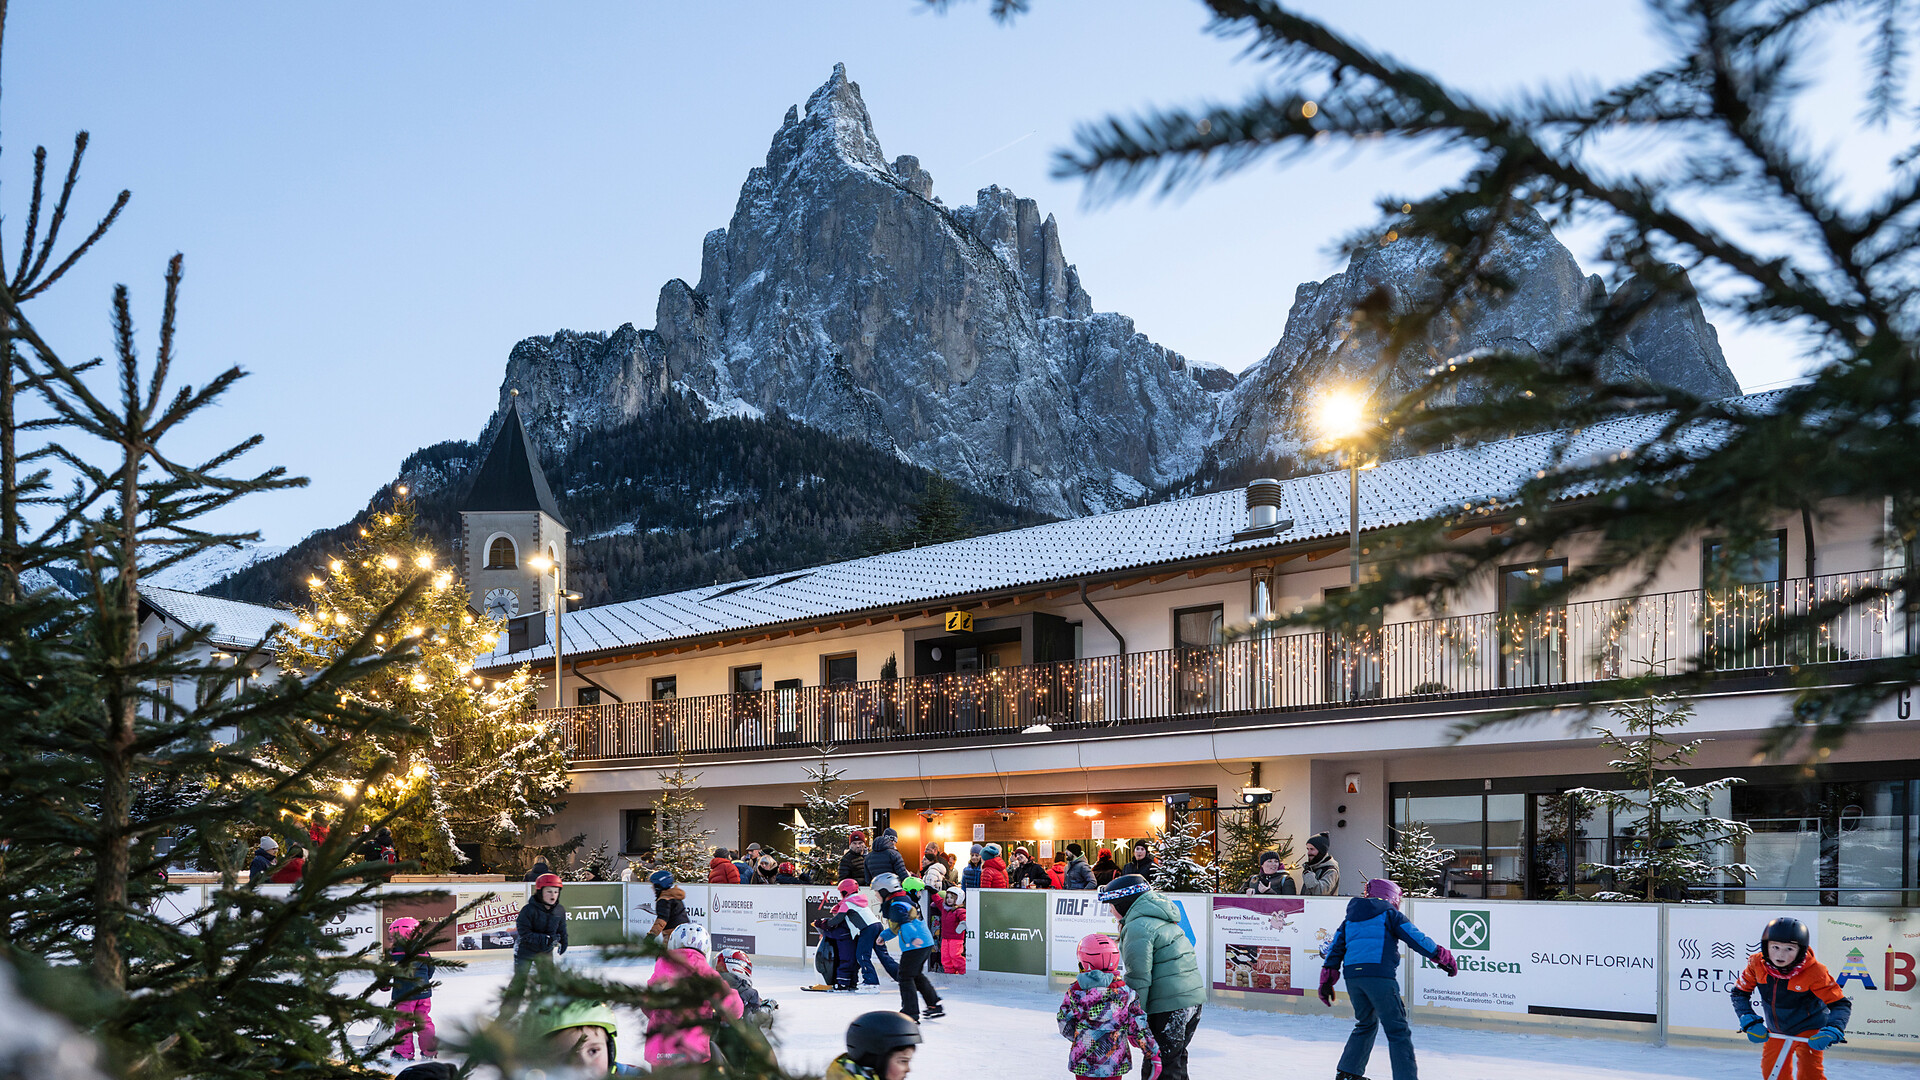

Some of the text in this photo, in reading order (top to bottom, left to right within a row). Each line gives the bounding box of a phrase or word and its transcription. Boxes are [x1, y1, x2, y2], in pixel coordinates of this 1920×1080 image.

[721, 900, 753, 910] JOCHBERGER
[807, 891, 839, 910] OBEXER
[475, 901, 520, 920] Albert
[1215, 913, 1242, 921] Metzgerei
[475, 920, 488, 928] 338
[489, 918, 498, 926] 29
[1827, 918, 1863, 929] Papierwaren
[1420, 954, 1522, 974] Rffeisen
[1531, 952, 1654, 969] SALON FLORIAN
[1423, 987, 1461, 996] Raiffeisenkasse
[1462, 990, 1489, 998] Kastelruth
[1463, 996, 1492, 1004] Castelrotto
[1885, 1000, 1912, 1010] Tabacchi
